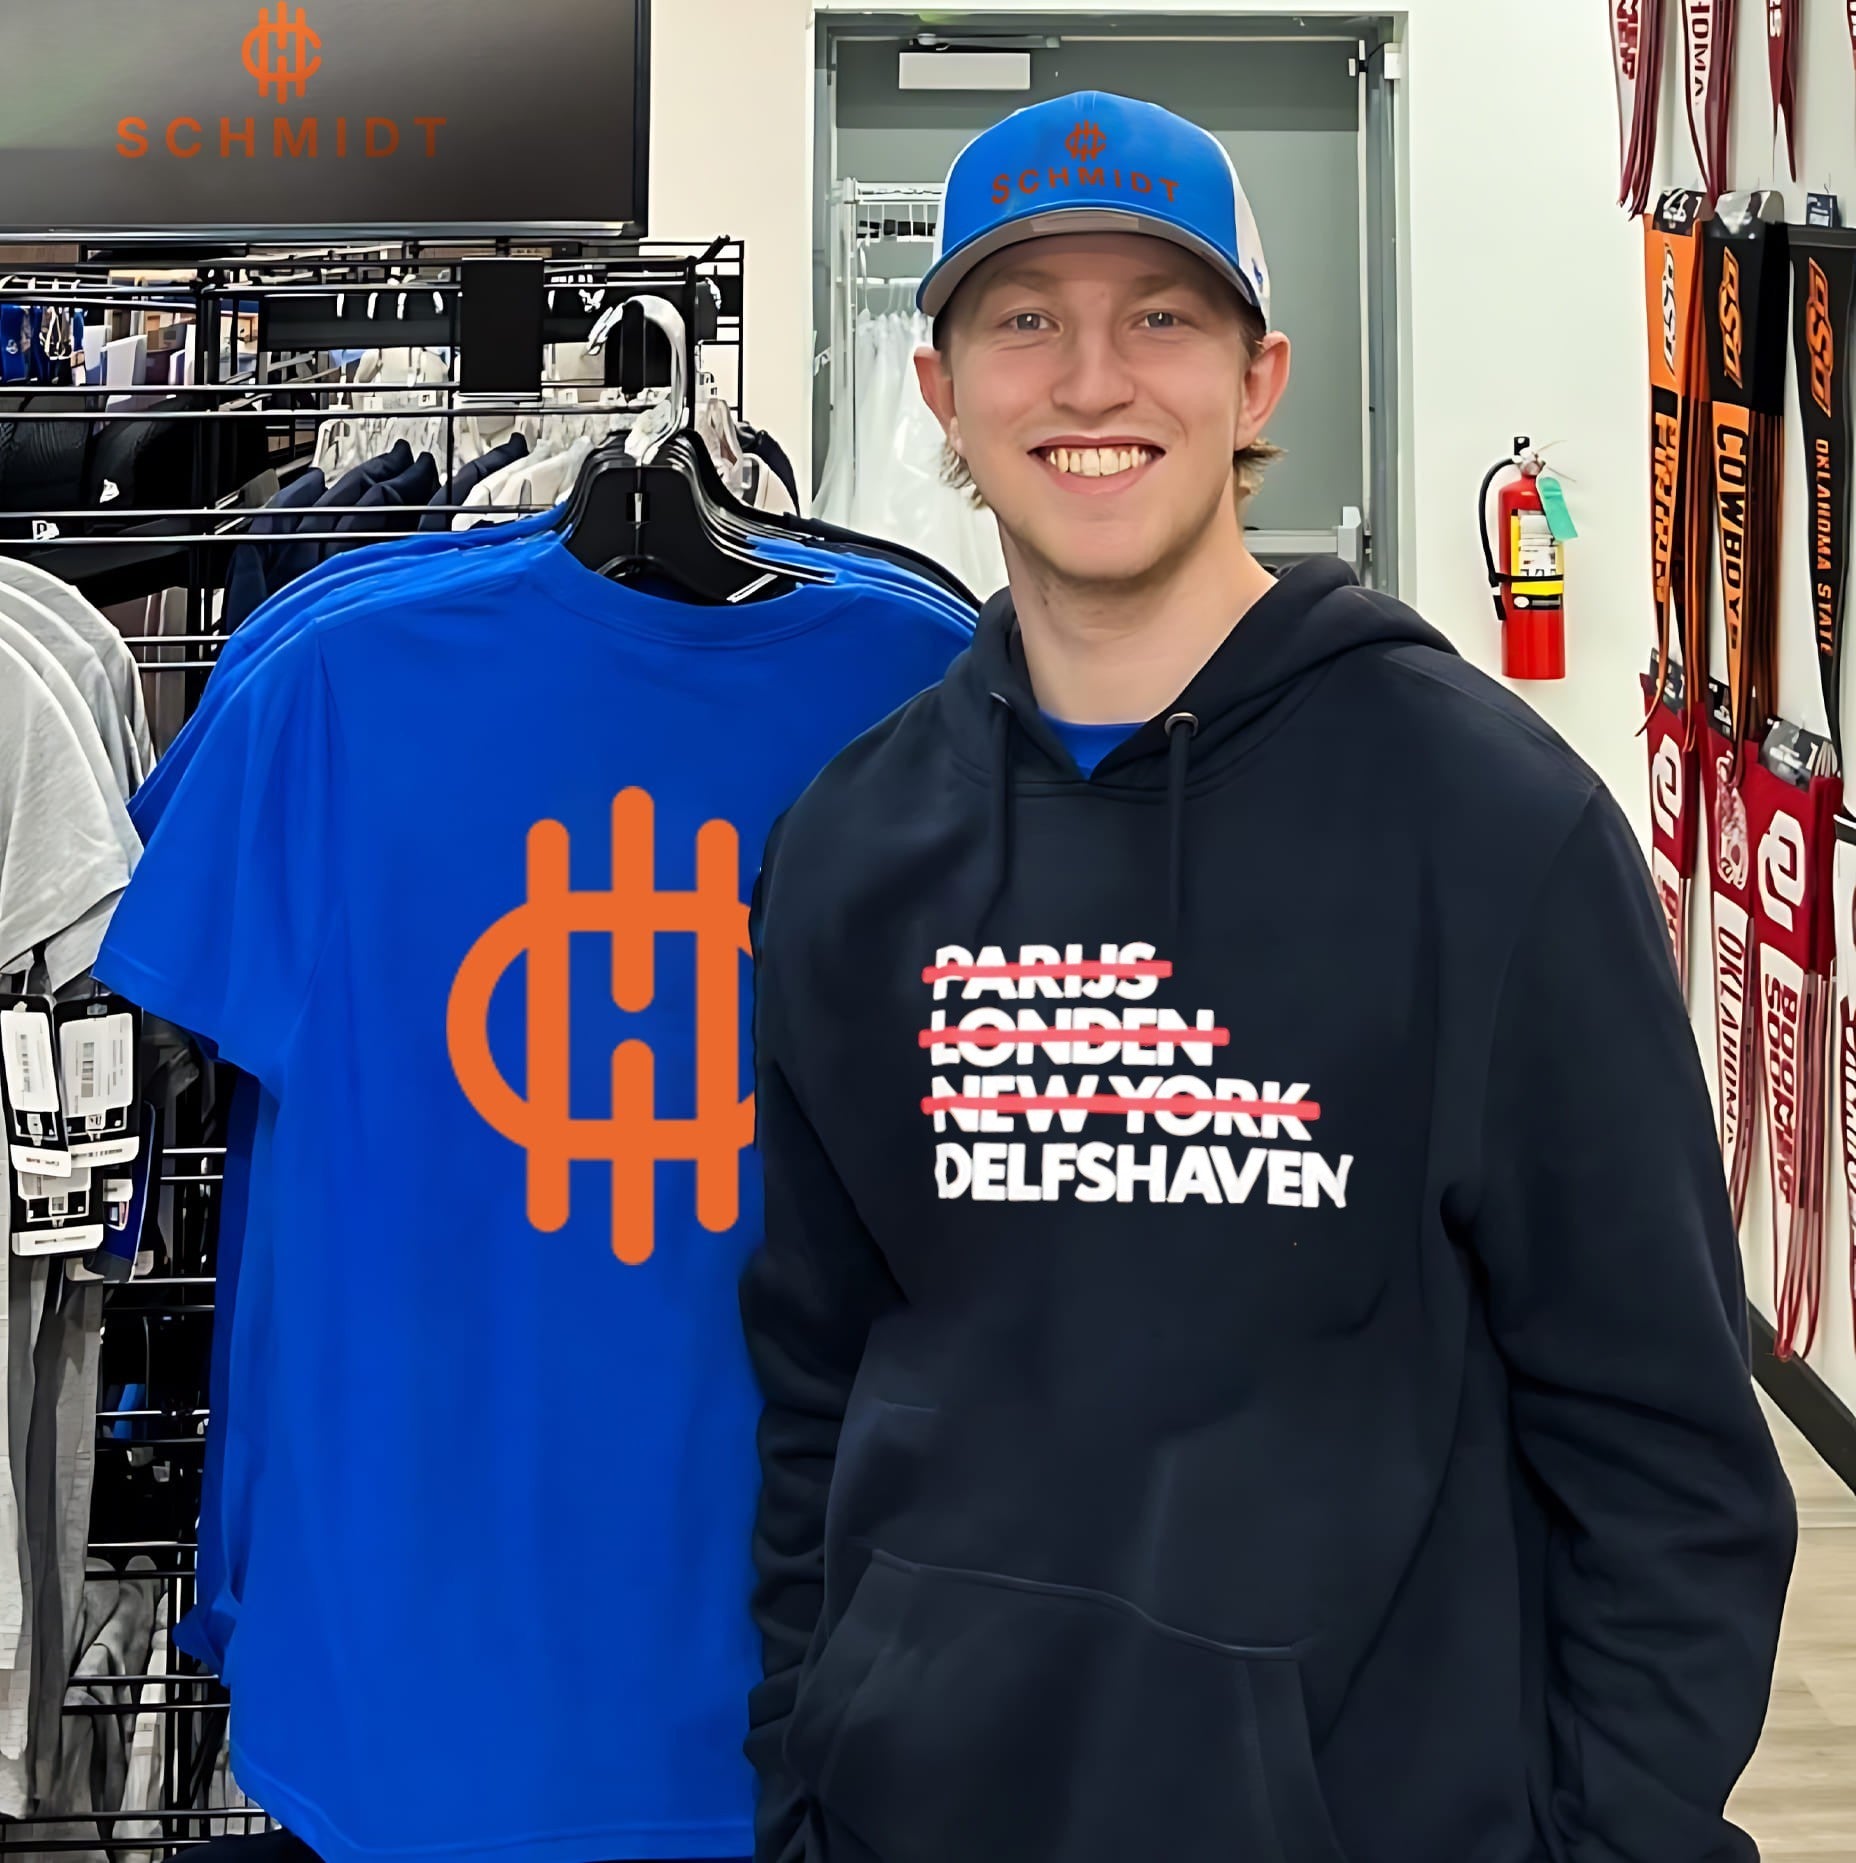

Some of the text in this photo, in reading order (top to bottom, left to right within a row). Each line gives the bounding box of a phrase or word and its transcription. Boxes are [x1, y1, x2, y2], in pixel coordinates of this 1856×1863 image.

[116, 117, 447, 158] SCHMIDT
[991, 166, 1180, 204] SCHMIDT
[932, 942, 1159, 1000] PARIJS
[930, 1007, 1215, 1067] LONDEN
[931, 1074, 1312, 1141] NEW YORK
[933, 1141, 1354, 1209] DELFSHAVEN
